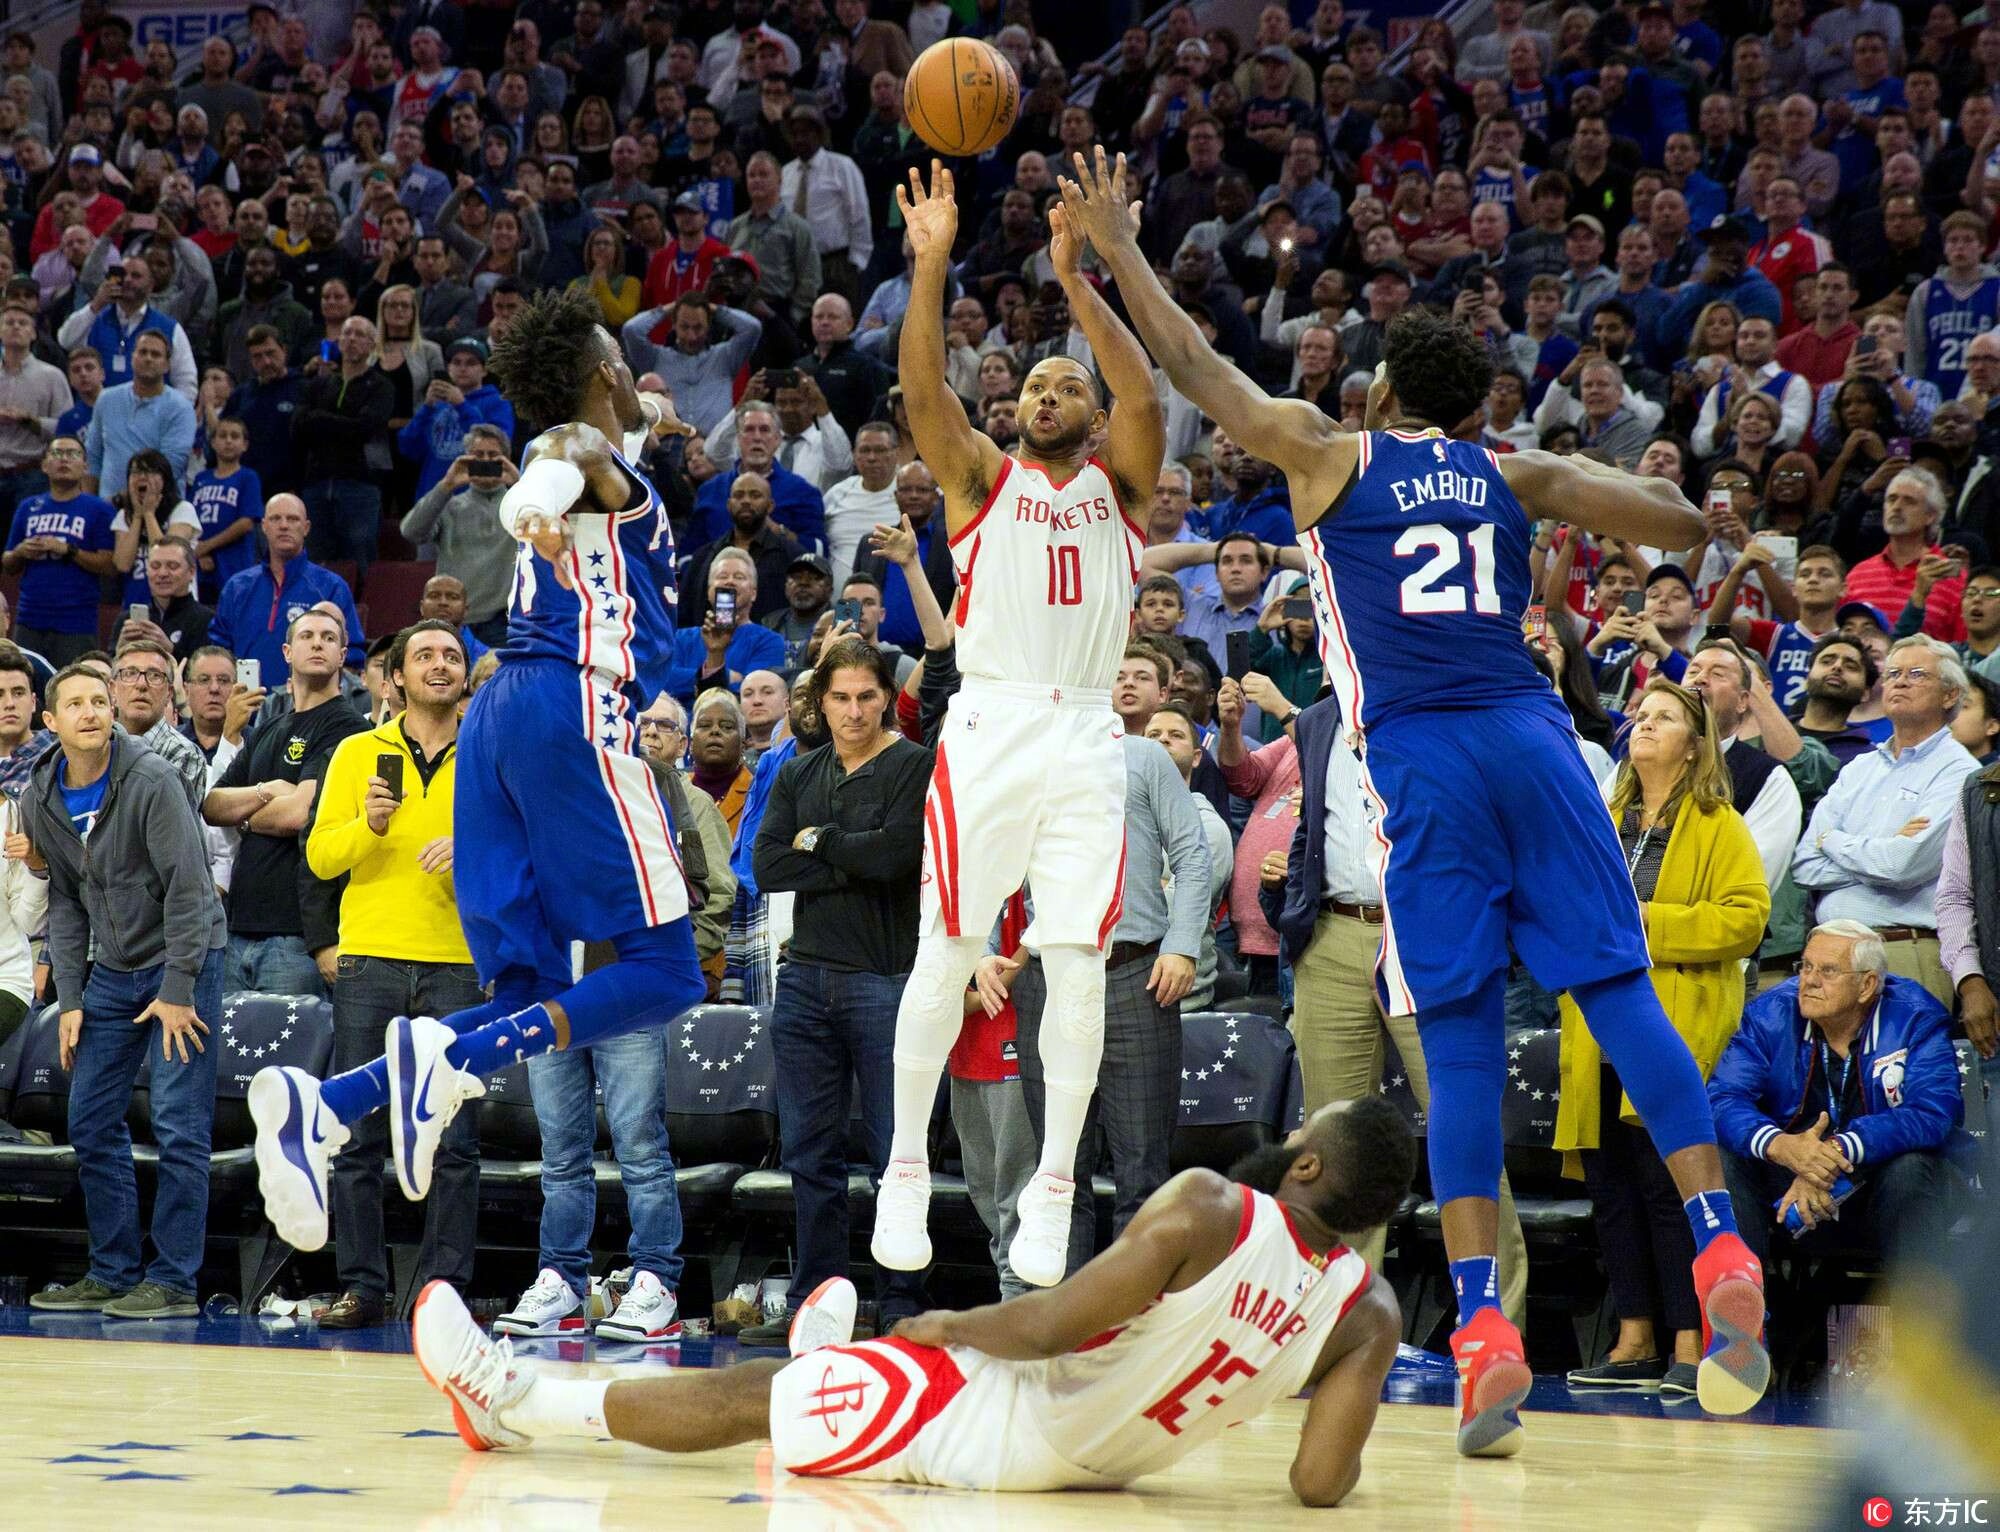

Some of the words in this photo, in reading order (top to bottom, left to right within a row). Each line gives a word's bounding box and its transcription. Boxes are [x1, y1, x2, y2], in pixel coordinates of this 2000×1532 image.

[138, 14, 252, 46] GEIC
[193, 484, 239, 507] PHILA
[201, 506, 220, 524] 21
[1016, 493, 1110, 532] ROKETS
[25, 513, 86, 540] PHILA
[1046, 544, 1083, 605] 10
[1392, 523, 1501, 616] 21
[1776, 649, 1812, 672] PHI
[1783, 675, 1808, 706] 2
[489, 1085, 505, 1093] EFL
[491, 1077, 507, 1085] SEC
[1186, 1107, 1190, 1115] 1
[1233, 1096, 1254, 1104] SEAT
[1531, 1119, 1552, 1127] ROW
